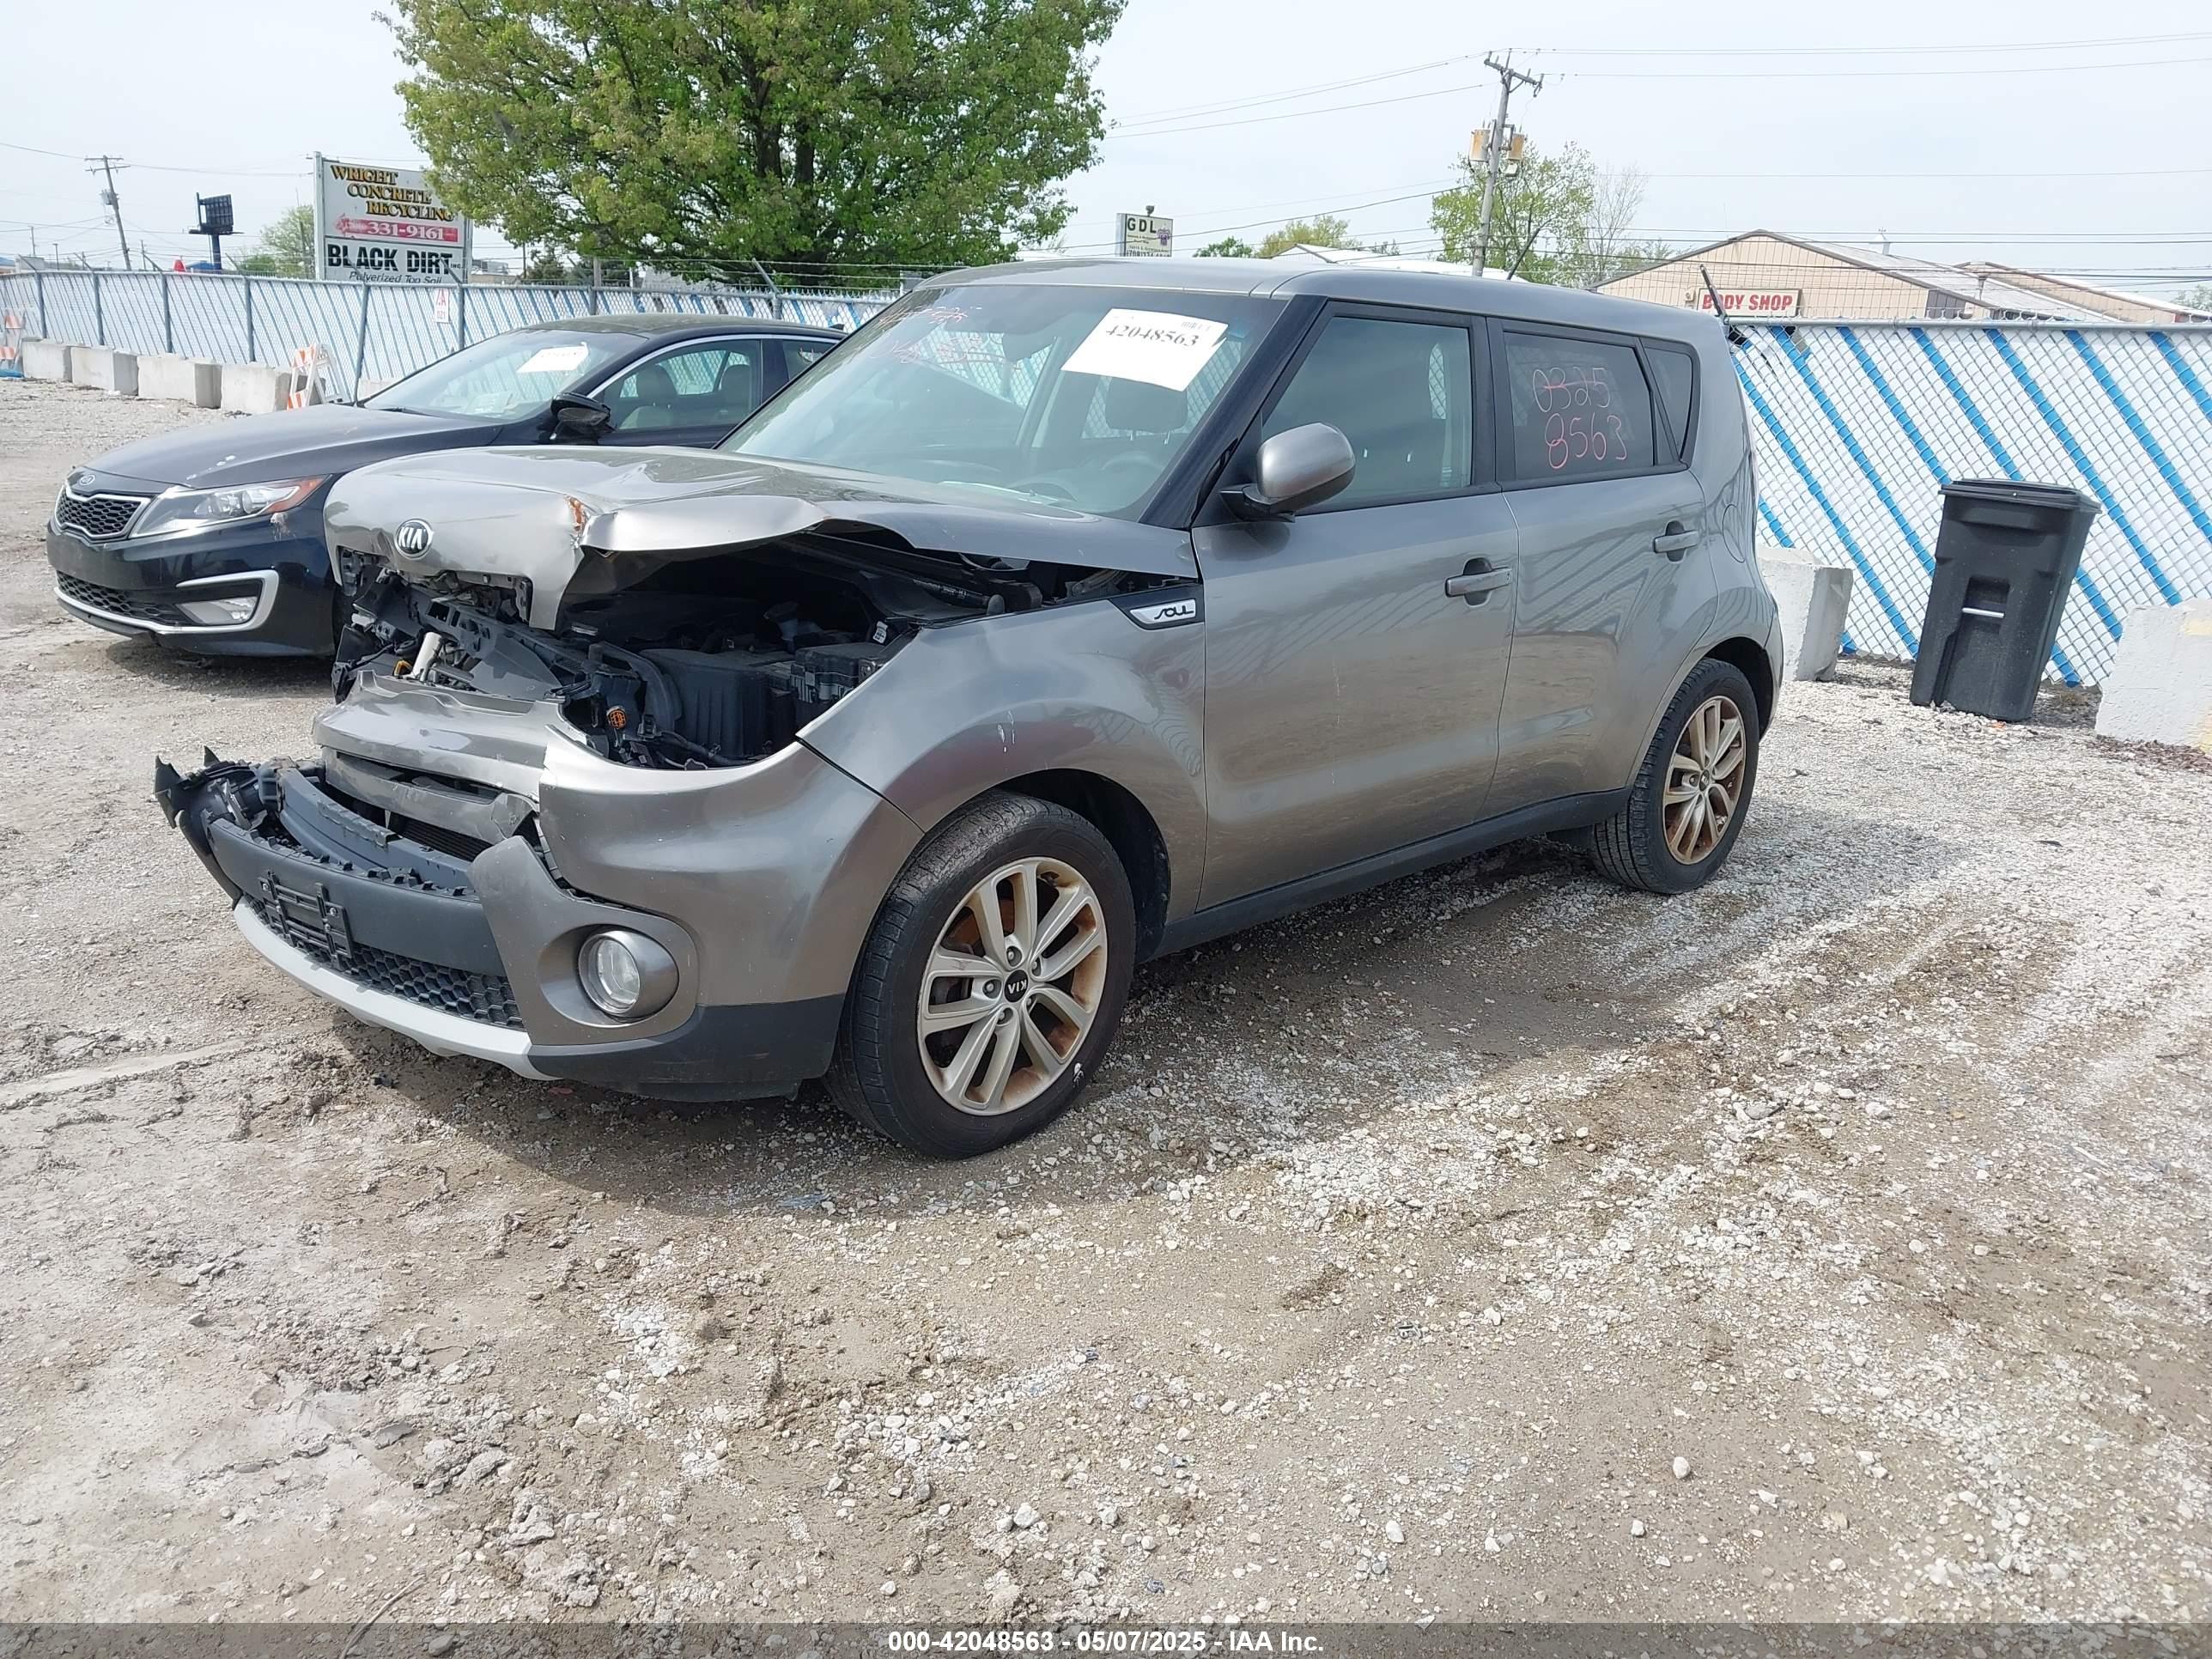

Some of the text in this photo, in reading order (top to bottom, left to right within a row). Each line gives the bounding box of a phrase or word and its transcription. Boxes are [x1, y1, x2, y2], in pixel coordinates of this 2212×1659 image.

[330, 164, 398, 185] WRIGHT
[347, 183, 432, 204] CONCRETE
[366, 200, 455, 222] RECYCLING
[367, 221, 445, 240] 331-9161
[327, 244, 398, 271] BLACK
[406, 250, 453, 275] DIRT
[1747, 294, 1793, 311] SHOP
[1105, 324, 1200, 347] 42048563
[1545, 412, 1627, 470] 8563
[398, 526, 422, 550] KIA
[1007, 979, 1027, 994] KIA
